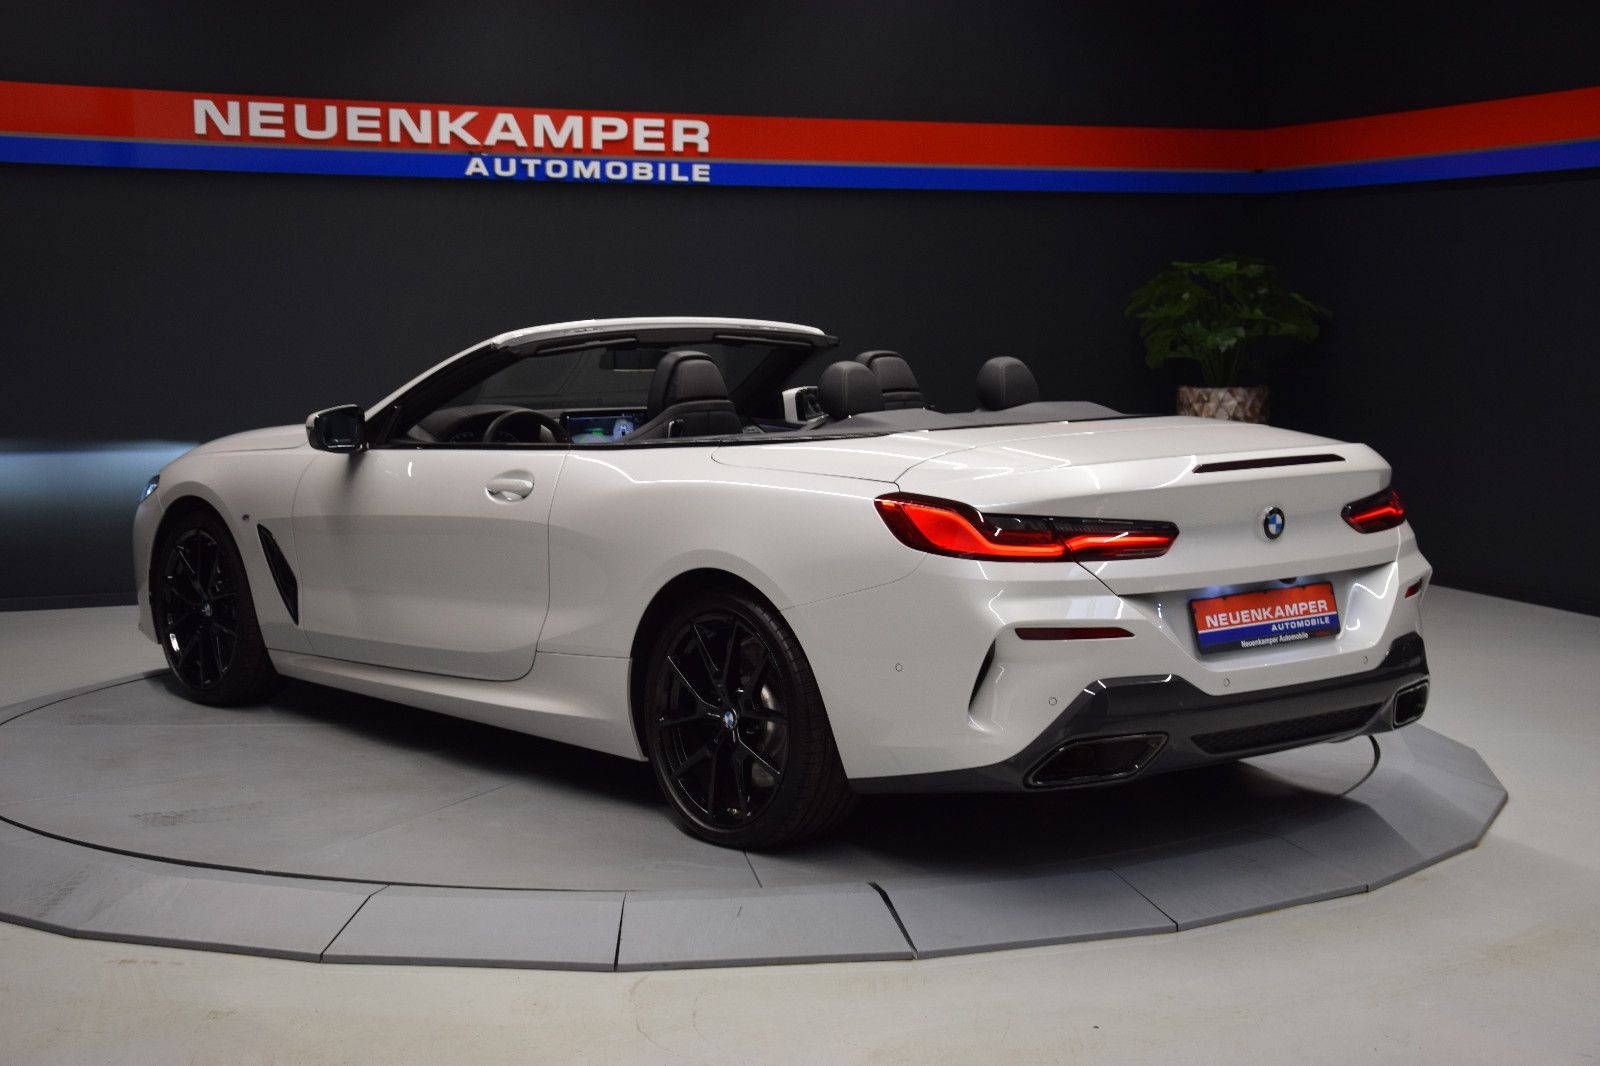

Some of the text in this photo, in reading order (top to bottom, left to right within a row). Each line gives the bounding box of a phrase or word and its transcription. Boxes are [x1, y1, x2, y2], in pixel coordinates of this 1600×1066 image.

[193, 99, 711, 153] NEUENKAMPER
[464, 156, 711, 183] AUTOMOBILE
[1205, 599, 1328, 628] NEUENKAMPER
[1271, 616, 1330, 632] AUTOMOBILE
[1241, 636, 1279, 648] Neuenkamper
[1279, 632, 1309, 643] Automobile
